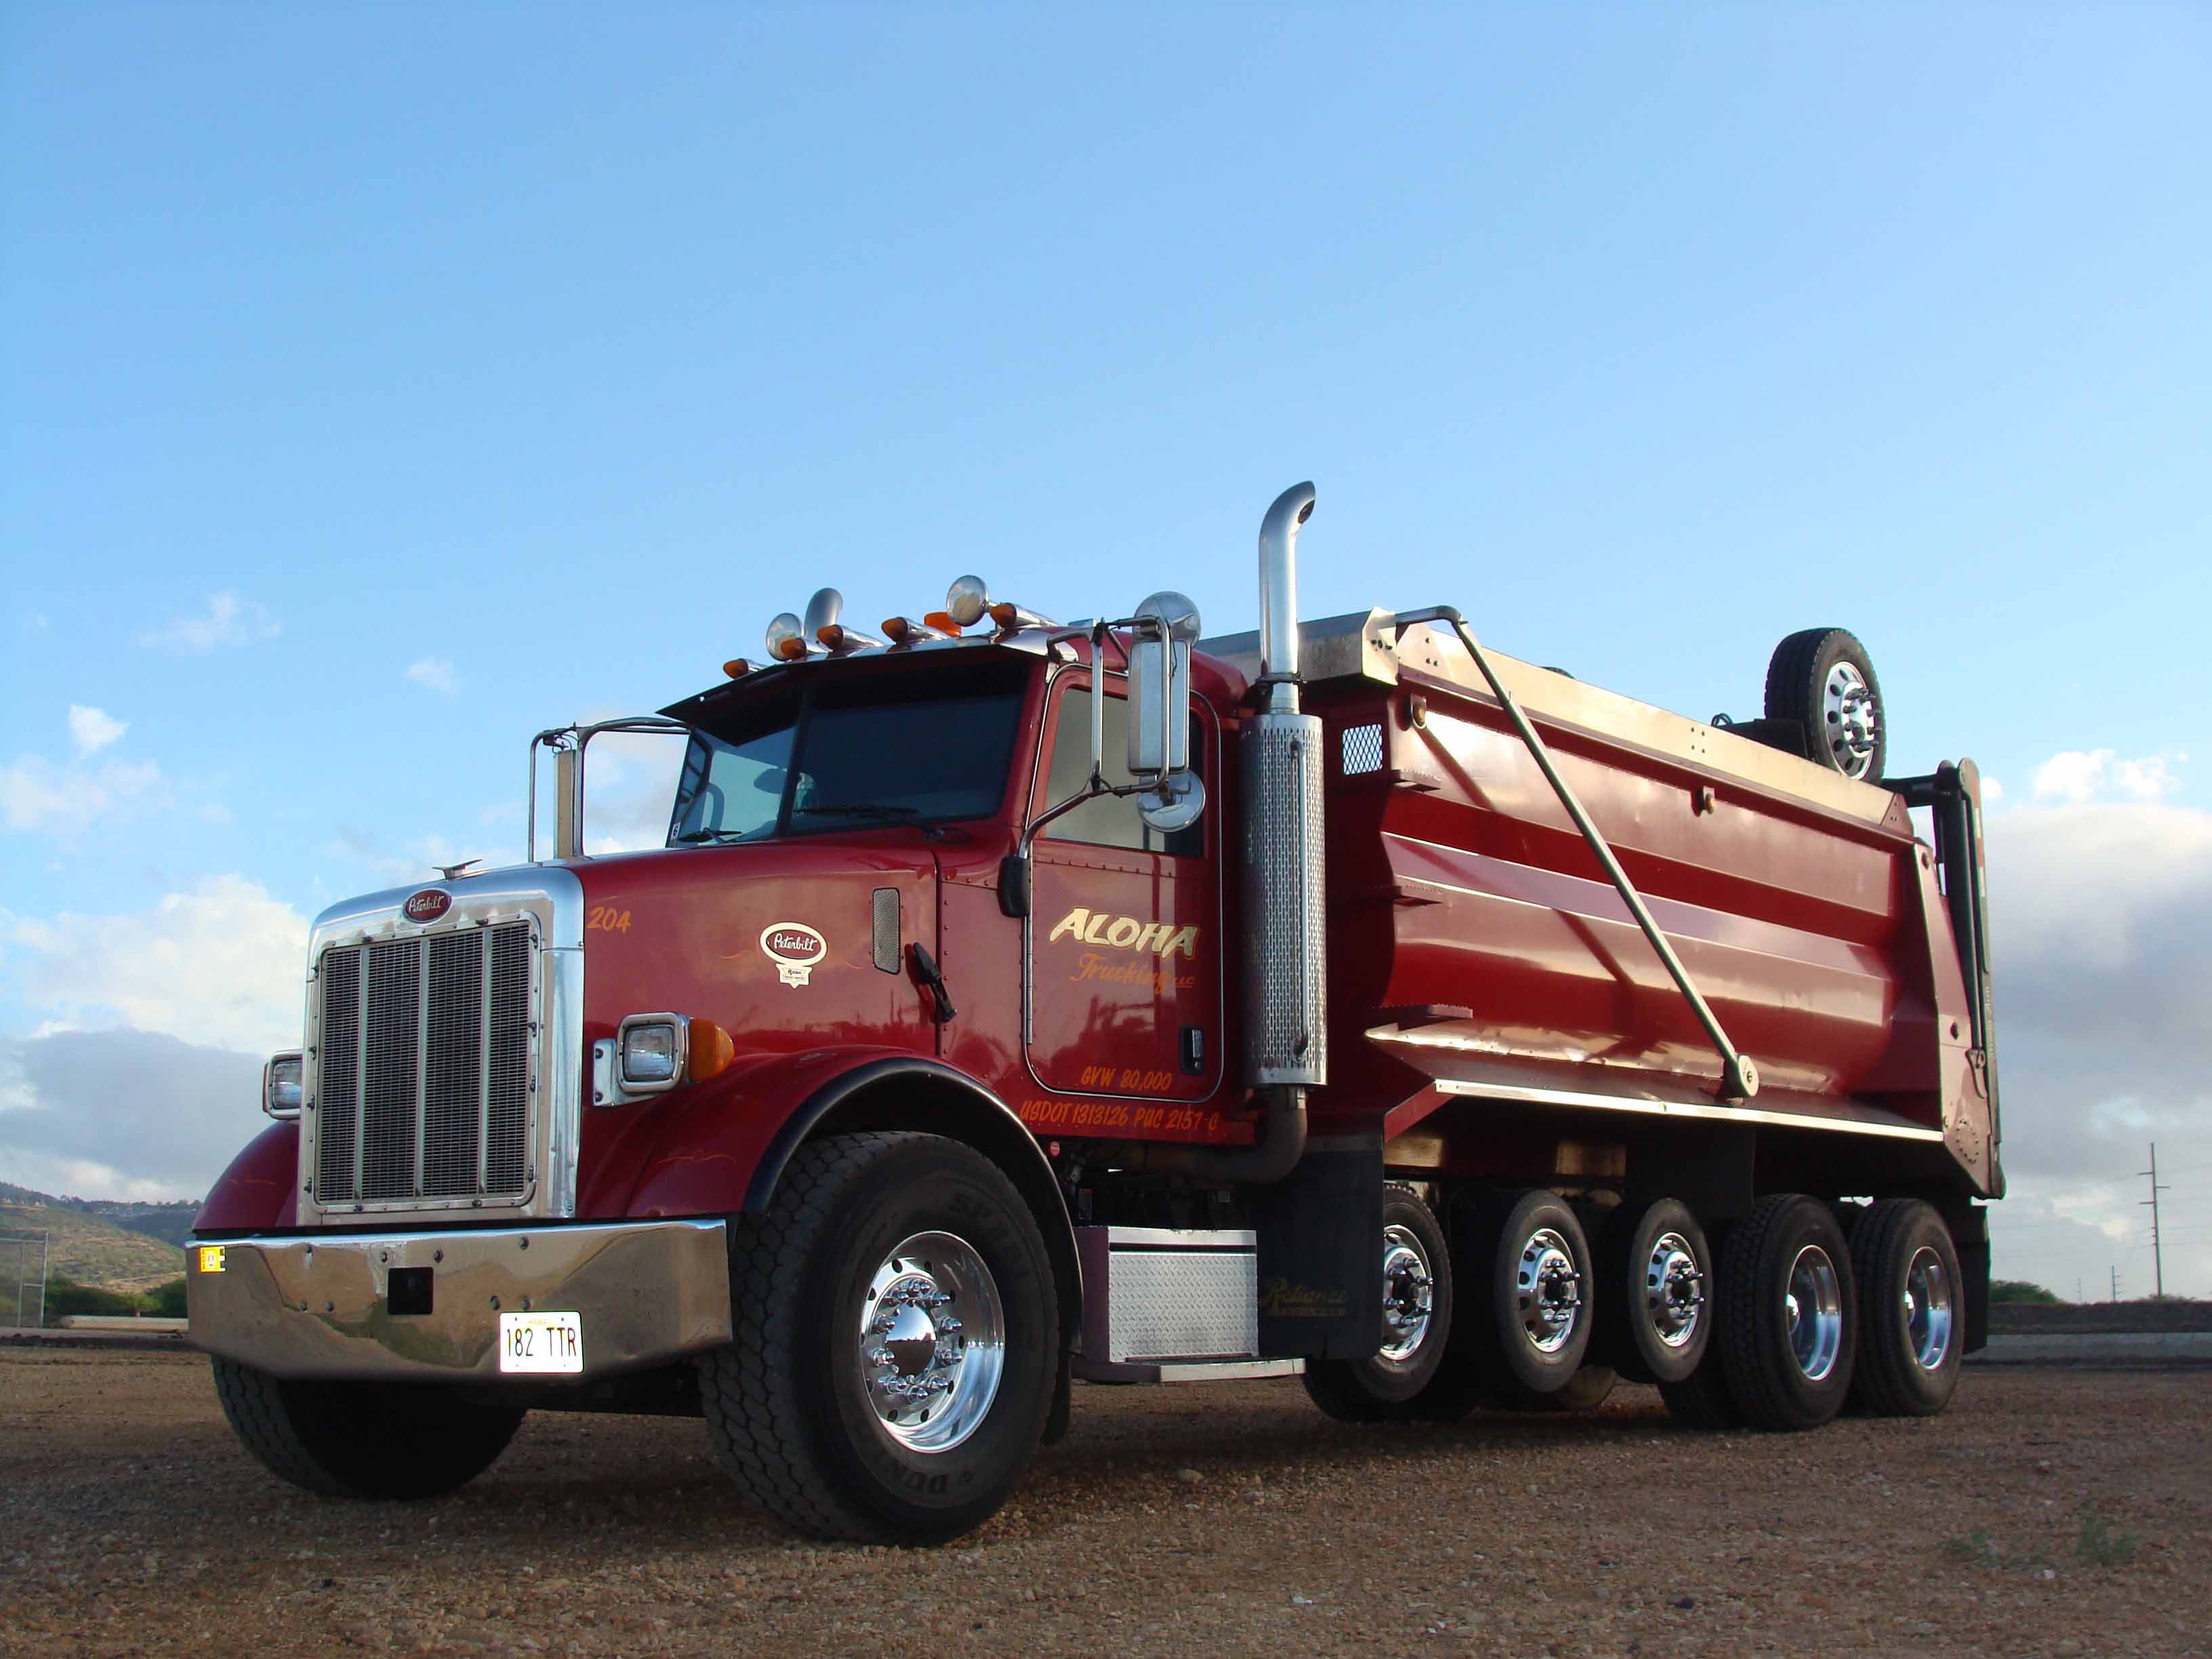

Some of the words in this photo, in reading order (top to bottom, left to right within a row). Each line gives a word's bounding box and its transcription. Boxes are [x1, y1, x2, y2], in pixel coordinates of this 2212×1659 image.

[587, 906, 632, 933] 204
[1048, 907, 1199, 959] ALOHA
[774, 933, 818, 951] Peterbilt
[1069, 953, 1172, 995] Trucking
[1080, 1066, 1117, 1088] GVW
[1120, 1069, 1172, 1090] 80,000
[1019, 1100, 1074, 1122] USDOT
[1072, 1103, 1129, 1127] 1313126
[1132, 1107, 1161, 1129] PUC
[507, 1328, 534, 1357] 182
[546, 1326, 577, 1357] TTR
